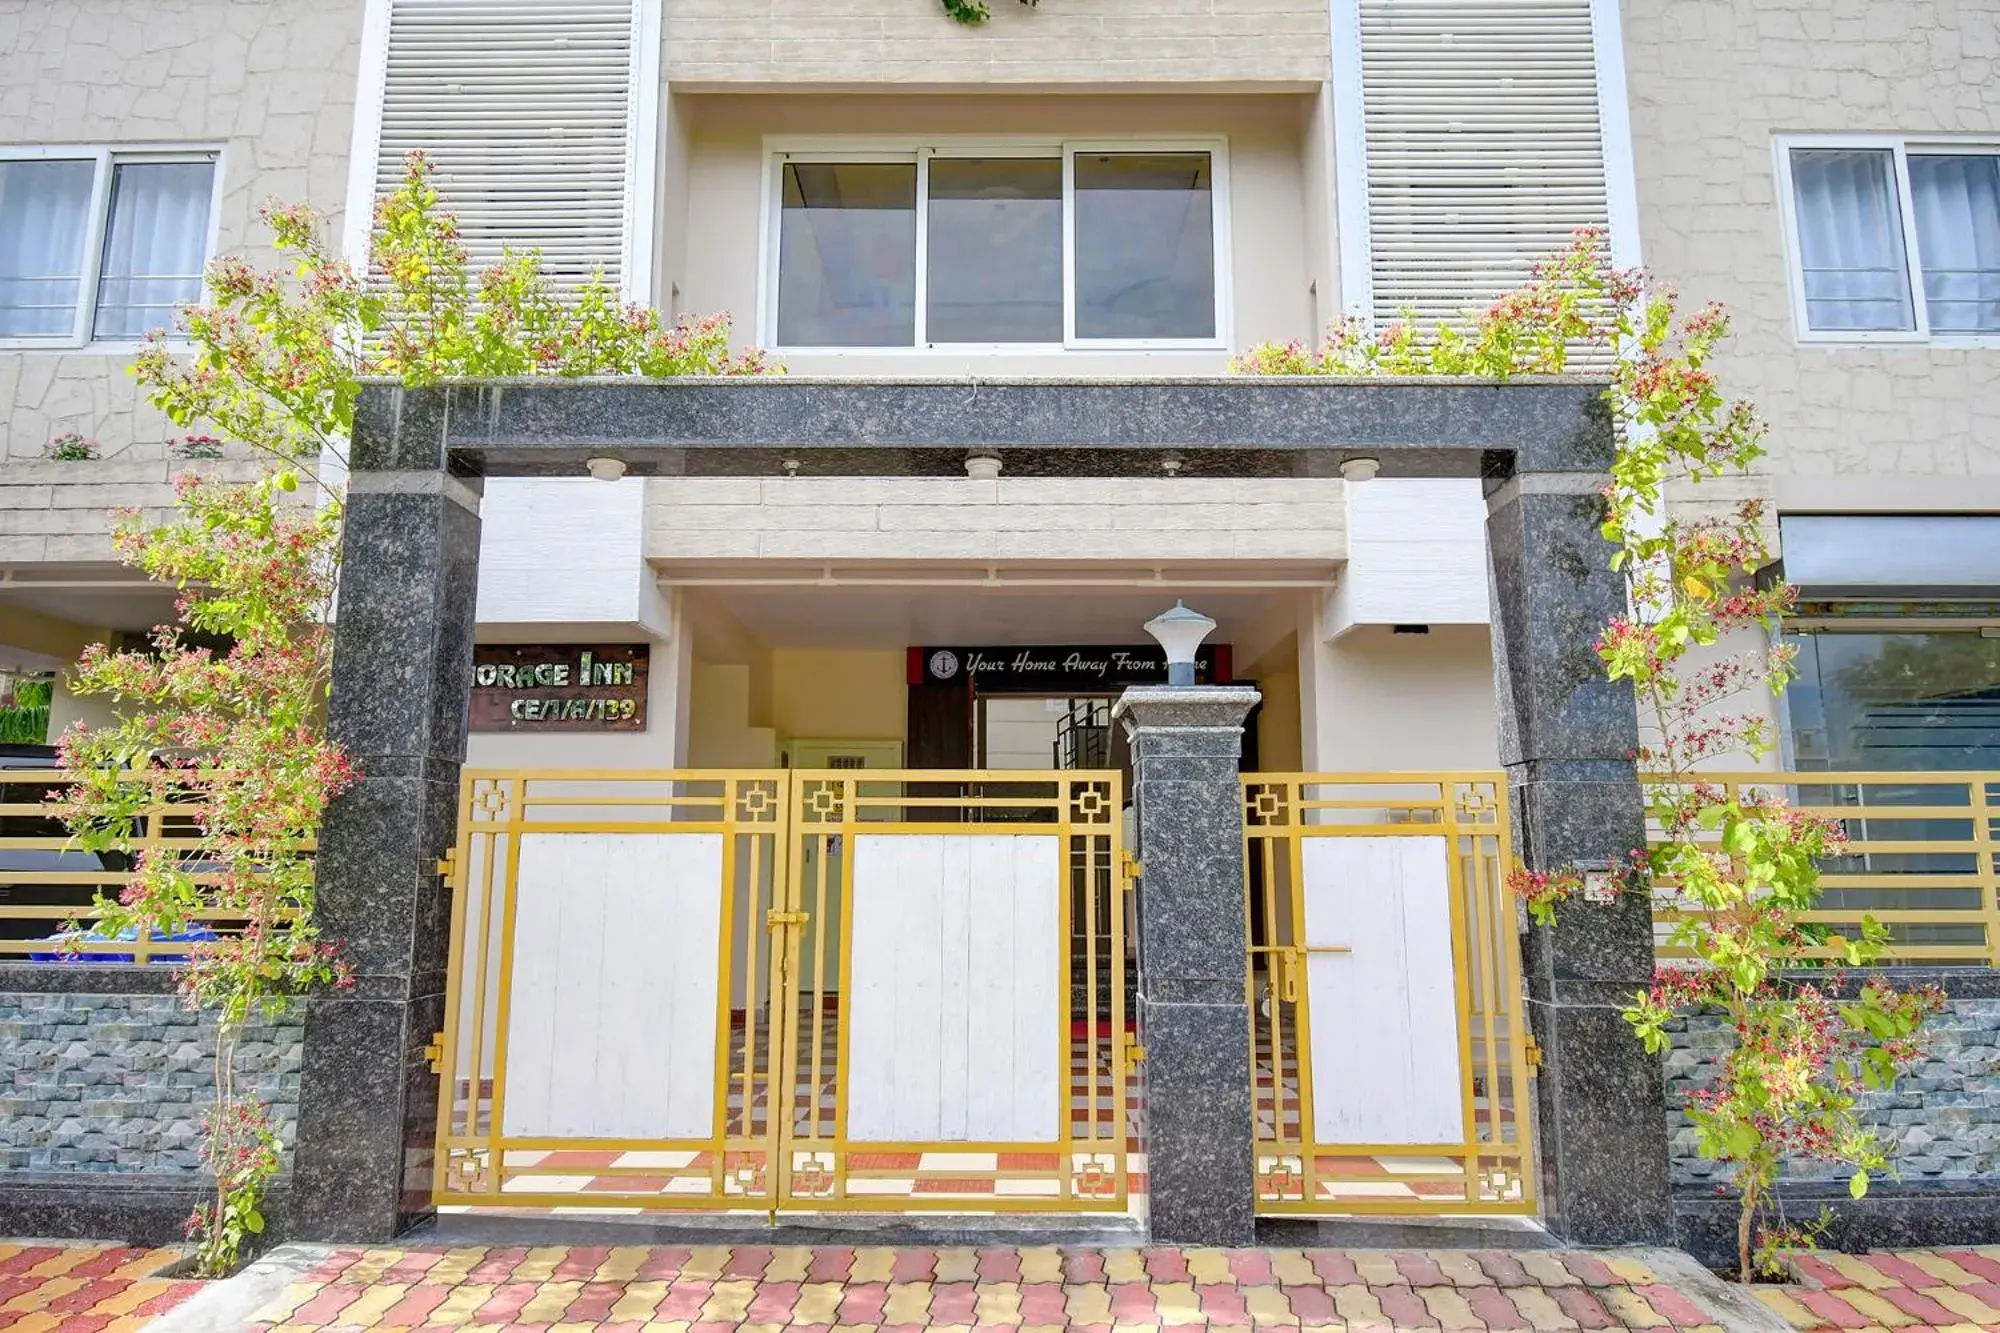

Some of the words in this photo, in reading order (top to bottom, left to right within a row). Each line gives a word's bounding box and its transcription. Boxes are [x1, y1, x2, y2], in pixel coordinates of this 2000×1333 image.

[966, 652, 1005, 677] Your
[1011, 650, 1056, 673] Home
[1062, 652, 1108, 677] Away
[1111, 652, 1155, 671] From
